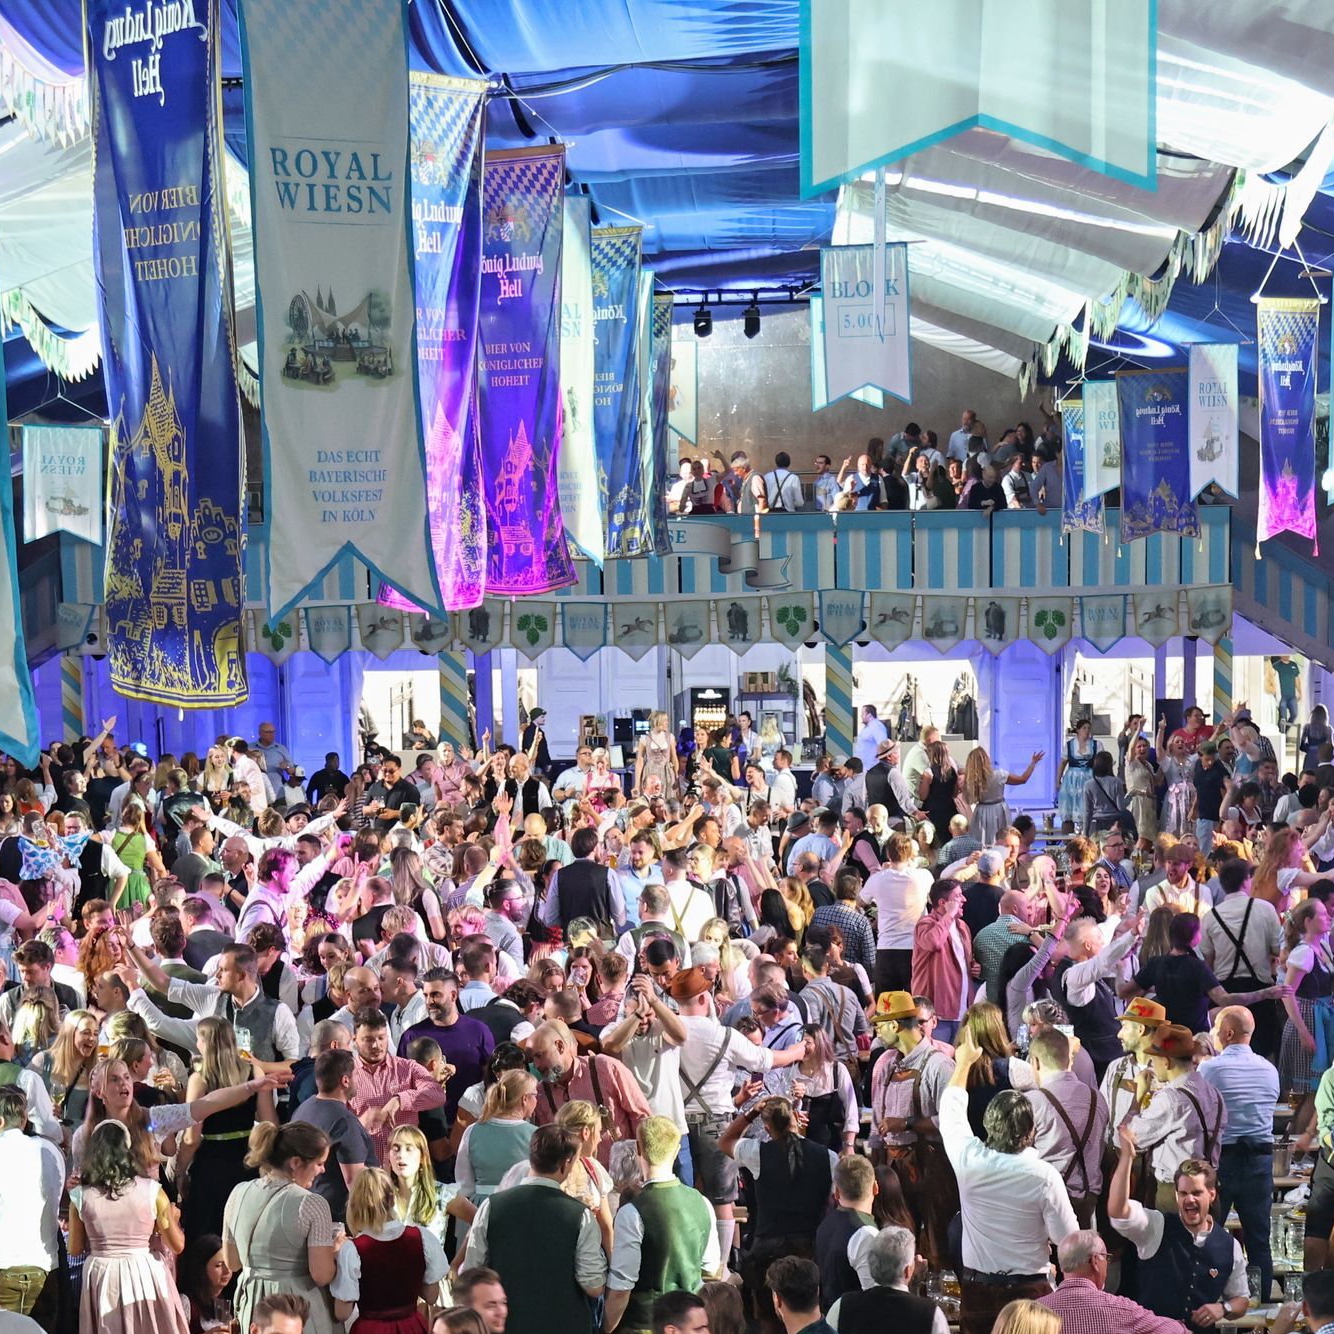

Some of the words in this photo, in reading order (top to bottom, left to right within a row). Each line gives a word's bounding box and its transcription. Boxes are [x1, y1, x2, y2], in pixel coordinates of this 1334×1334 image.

[269, 147, 393, 182] ROYAL
[275, 180, 393, 214] WIESN
[416, 229, 442, 260] Hell
[503, 252, 544, 277] Ludwig
[497, 279, 523, 304] Hell
[831, 279, 900, 299] BLOK
[510, 342, 531, 353] VON
[491, 375, 530, 387] HOHEIT
[317, 450, 344, 463] DAS
[347, 450, 381, 463] ECHT
[322, 509, 338, 523] IN
[342, 506, 376, 522] KÖLN
